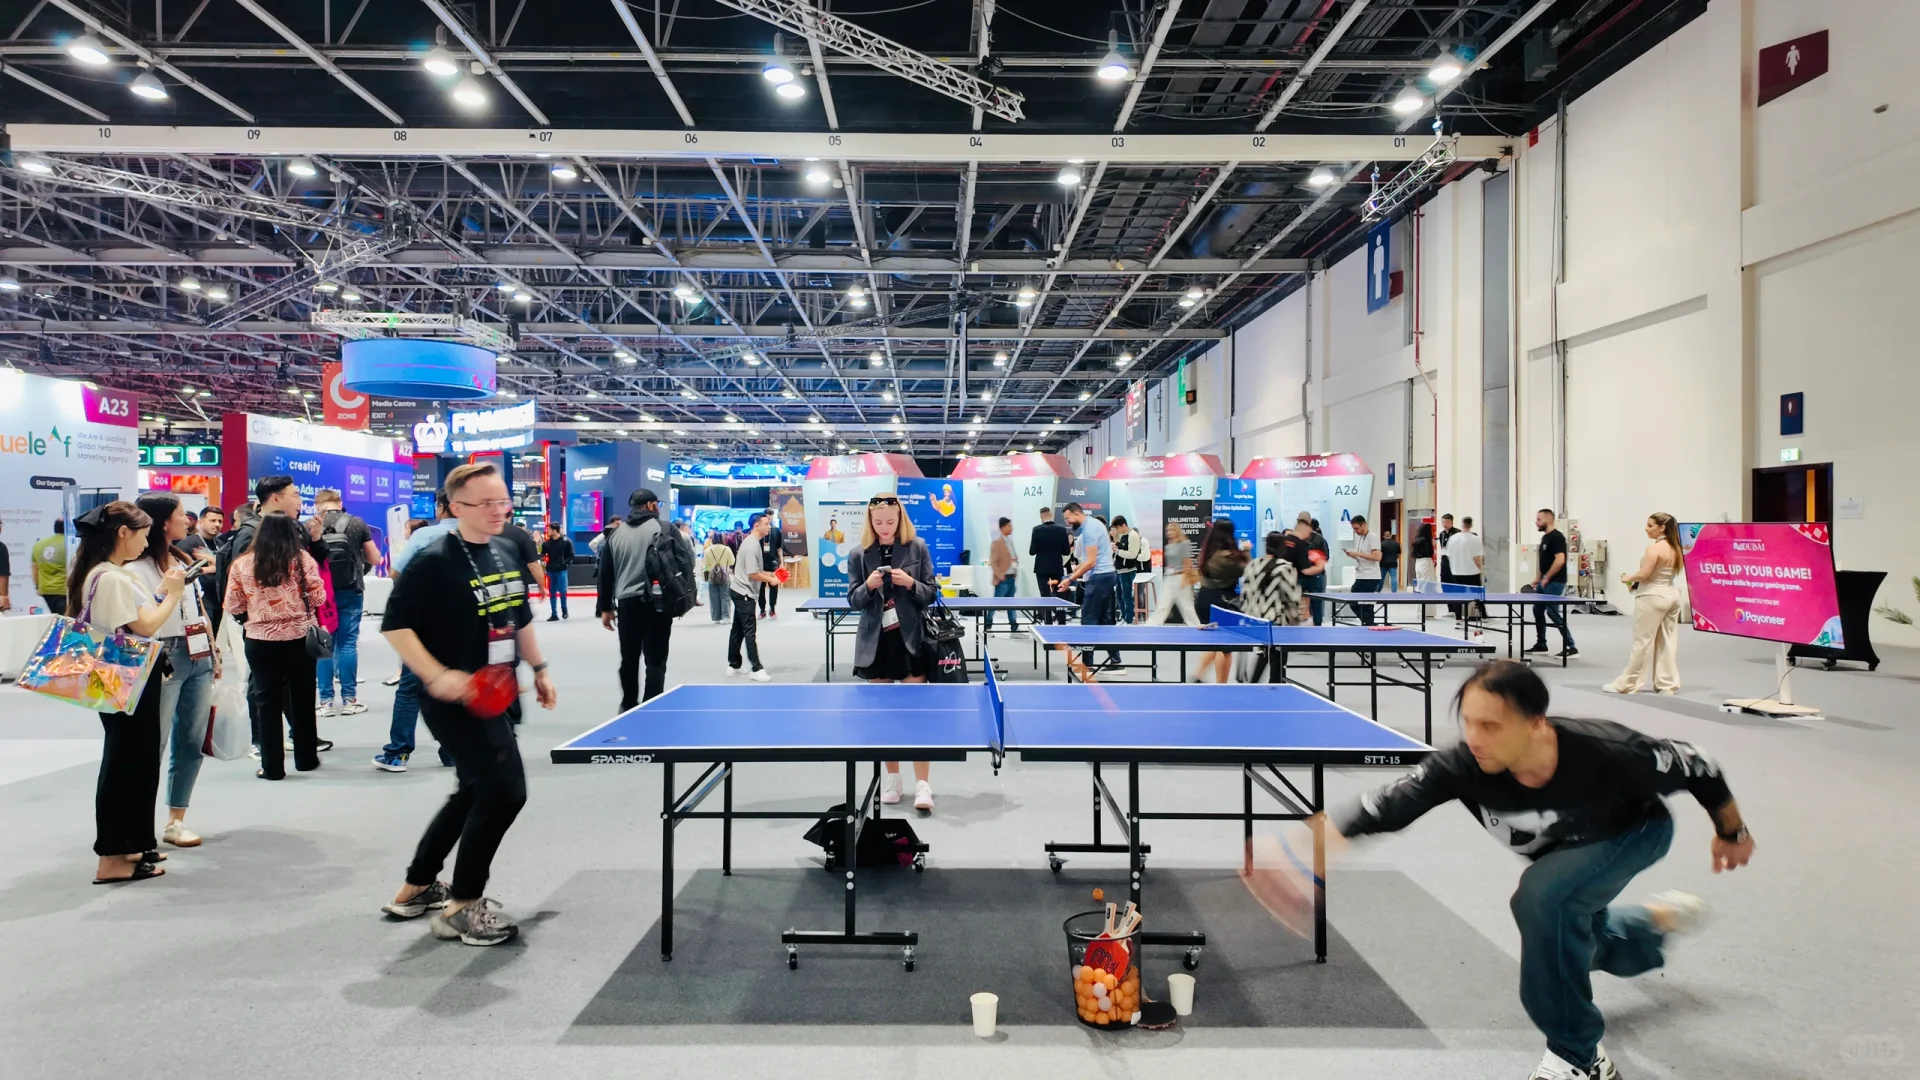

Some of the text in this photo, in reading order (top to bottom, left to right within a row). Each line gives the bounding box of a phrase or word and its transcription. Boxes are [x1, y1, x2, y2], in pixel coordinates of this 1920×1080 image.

[98, 128, 111, 138] 10
[247, 129, 261, 140] 09
[393, 130, 407, 141] 08
[539, 131, 553, 142] 07
[684, 133, 698, 144] 06
[828, 135, 842, 146] 05
[969, 136, 983, 147] 04
[1111, 137, 1125, 148] 03
[1252, 136, 1266, 147] 02
[1394, 137, 1406, 148] 01
[98, 397, 129, 417] A23
[371, 400, 417, 408] Media Centre
[337, 412, 357, 420] ZONE
[77, 442, 97, 451] Global
[399, 442, 413, 458] A22
[77, 452, 107, 464] Marketing
[289, 459, 321, 475] creatify
[827, 458, 867, 475] ZONE A
[1277, 458, 1328, 470] OHOO ADS
[154, 477, 169, 486] C04
[351, 474, 366, 485] 90%
[301, 483, 315, 496] Ads
[1023, 485, 1043, 497] A24
[1070, 488, 1085, 497] Adpos
[1180, 486, 1203, 497] A25
[1334, 484, 1359, 496] A26
[301, 503, 317, 514] Mark
[1178, 504, 1197, 512] Adpos
[1700, 563, 1812, 580] LEVEL UP YOUR GAME!
[1765, 582, 1786, 591] gaming
[1735, 596, 1756, 604] BROUGHT
[1745, 611, 1785, 625] Payoneer
[1364, 754, 1401, 765] STT-15
